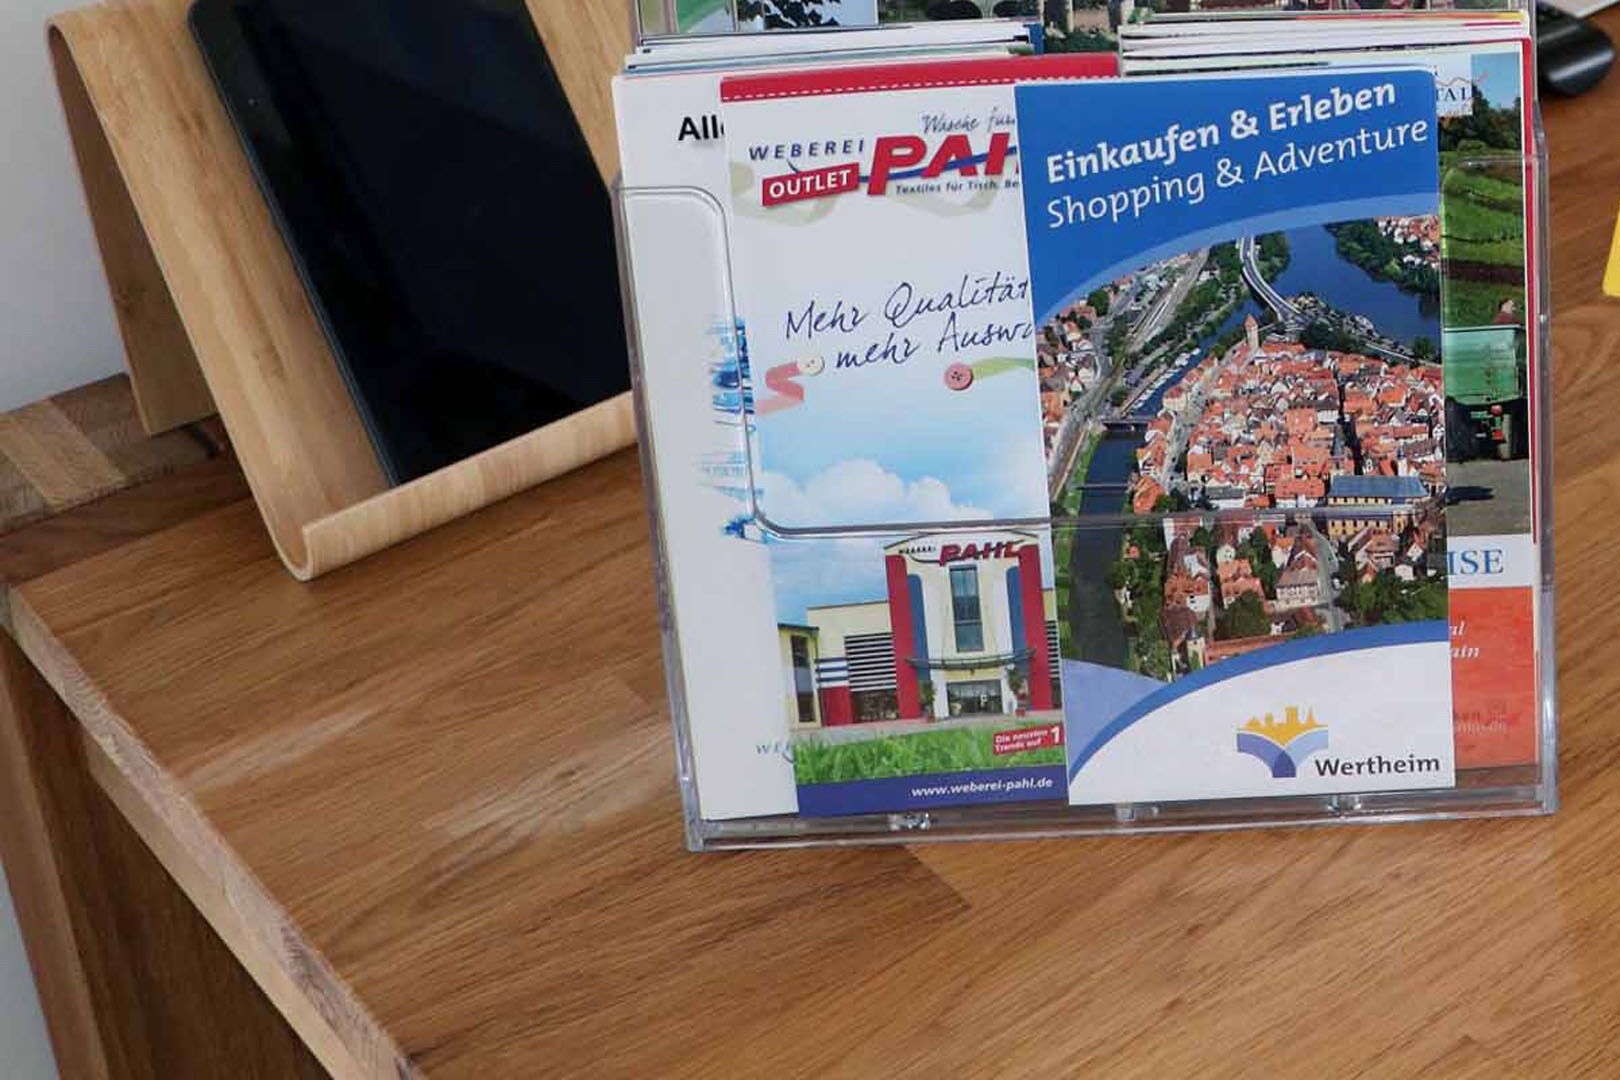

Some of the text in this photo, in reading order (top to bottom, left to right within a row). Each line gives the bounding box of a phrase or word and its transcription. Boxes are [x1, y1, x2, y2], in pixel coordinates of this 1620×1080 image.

[1046, 80, 1396, 184] Einkaufen & Erleben
[749, 139, 865, 160] WEBEREI
[769, 169, 851, 199] OUTLET
[1046, 119, 1428, 229] Shopping & Adventure
[785, 301, 869, 340] Mehr
[836, 335, 919, 370] mehr
[1315, 746, 1440, 777] Wertheim
[911, 776, 1053, 797] www.weberei-pahl.de
